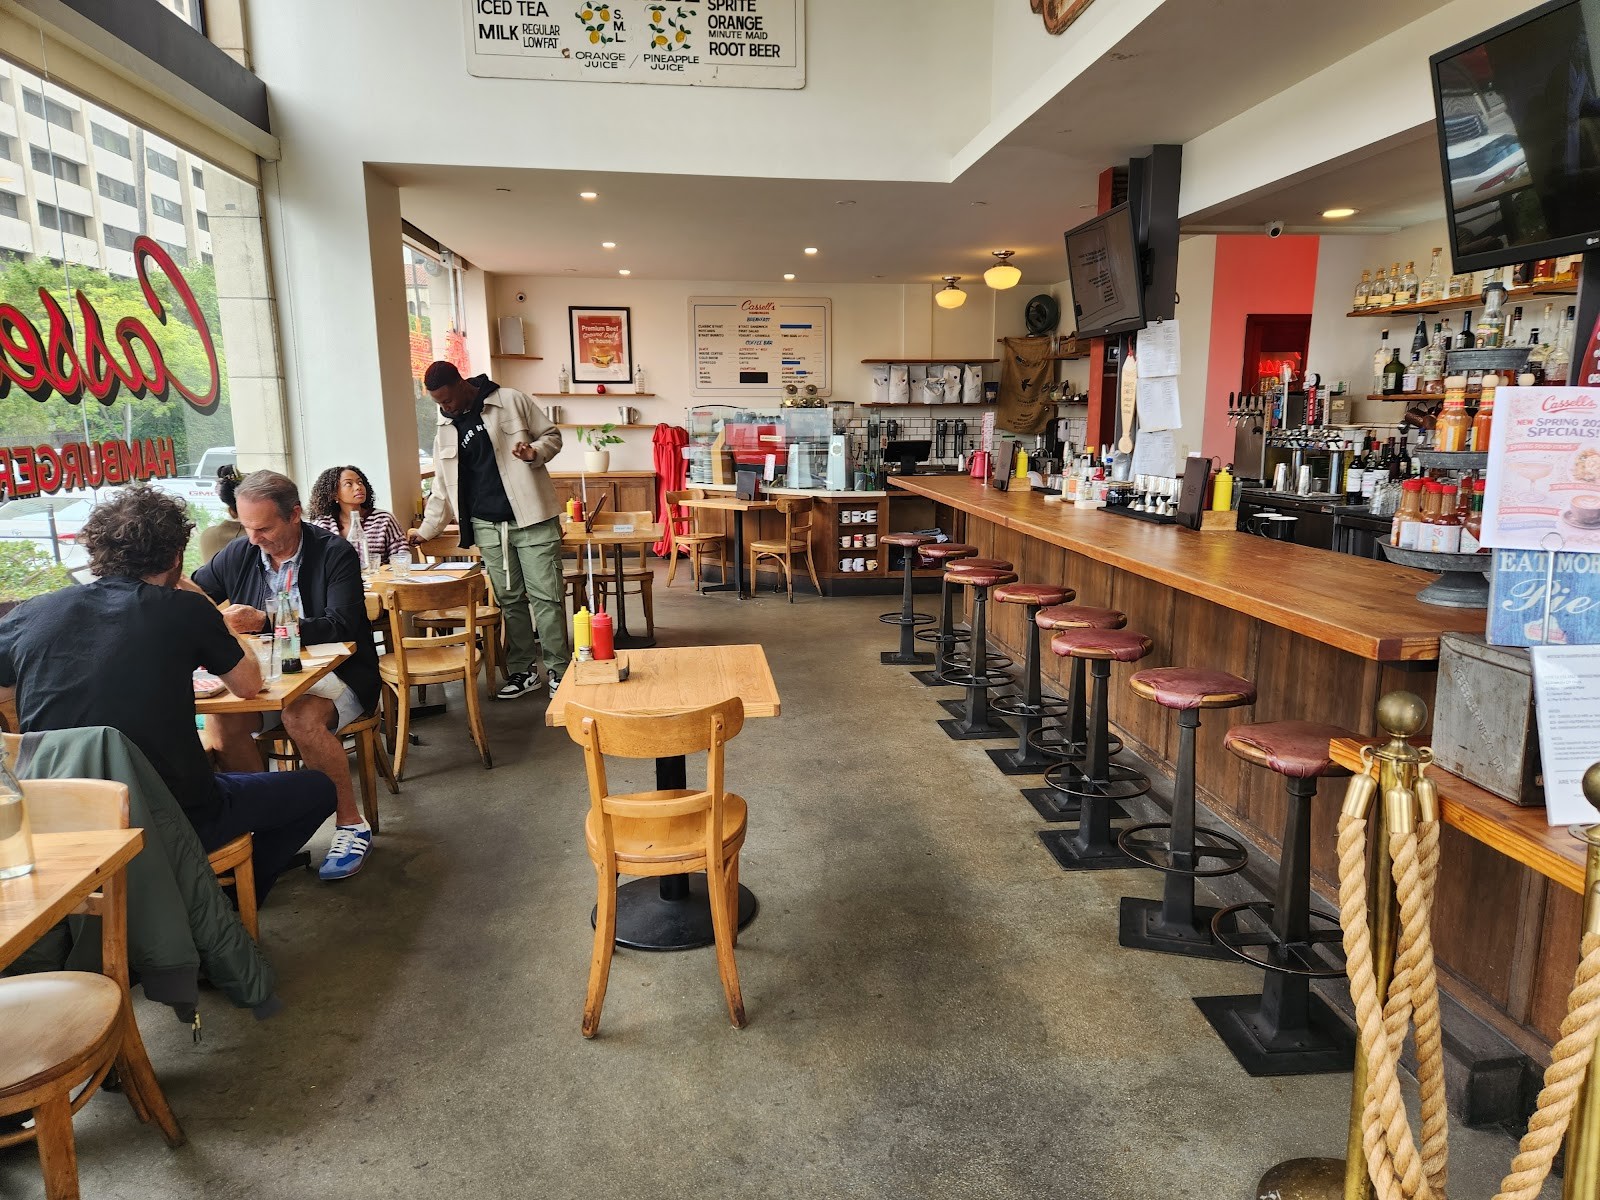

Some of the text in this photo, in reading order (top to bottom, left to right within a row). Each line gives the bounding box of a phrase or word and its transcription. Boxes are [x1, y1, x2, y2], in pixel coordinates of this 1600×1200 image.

[477, 0, 549, 17] ICED TEA
[708, 0, 756, 12] SPRITE
[708, 14, 763, 31] ORANGE
[479, 24, 519, 40] MILK
[522, 23, 560, 36] REGULAR
[708, 30, 768, 40] MINUTE MAID
[523, 37, 559, 49] LOWFAT
[709, 41, 781, 58] ROOT BEER
[575, 52, 626, 61] ORANGE
[643, 53, 700, 64] PINEAPPLE
[584, 61, 618, 69] JUICE
[650, 63, 685, 72] JUICE
[741, 299, 775, 311] Cassell's
[1542, 395, 1597, 413] Cassell's
[1536, 417, 1579, 426] SPRING
[1527, 427, 1600, 438] SPECIALS!
[1499, 552, 1549, 572] EAT
[1502, 578, 1600, 614] Pie
